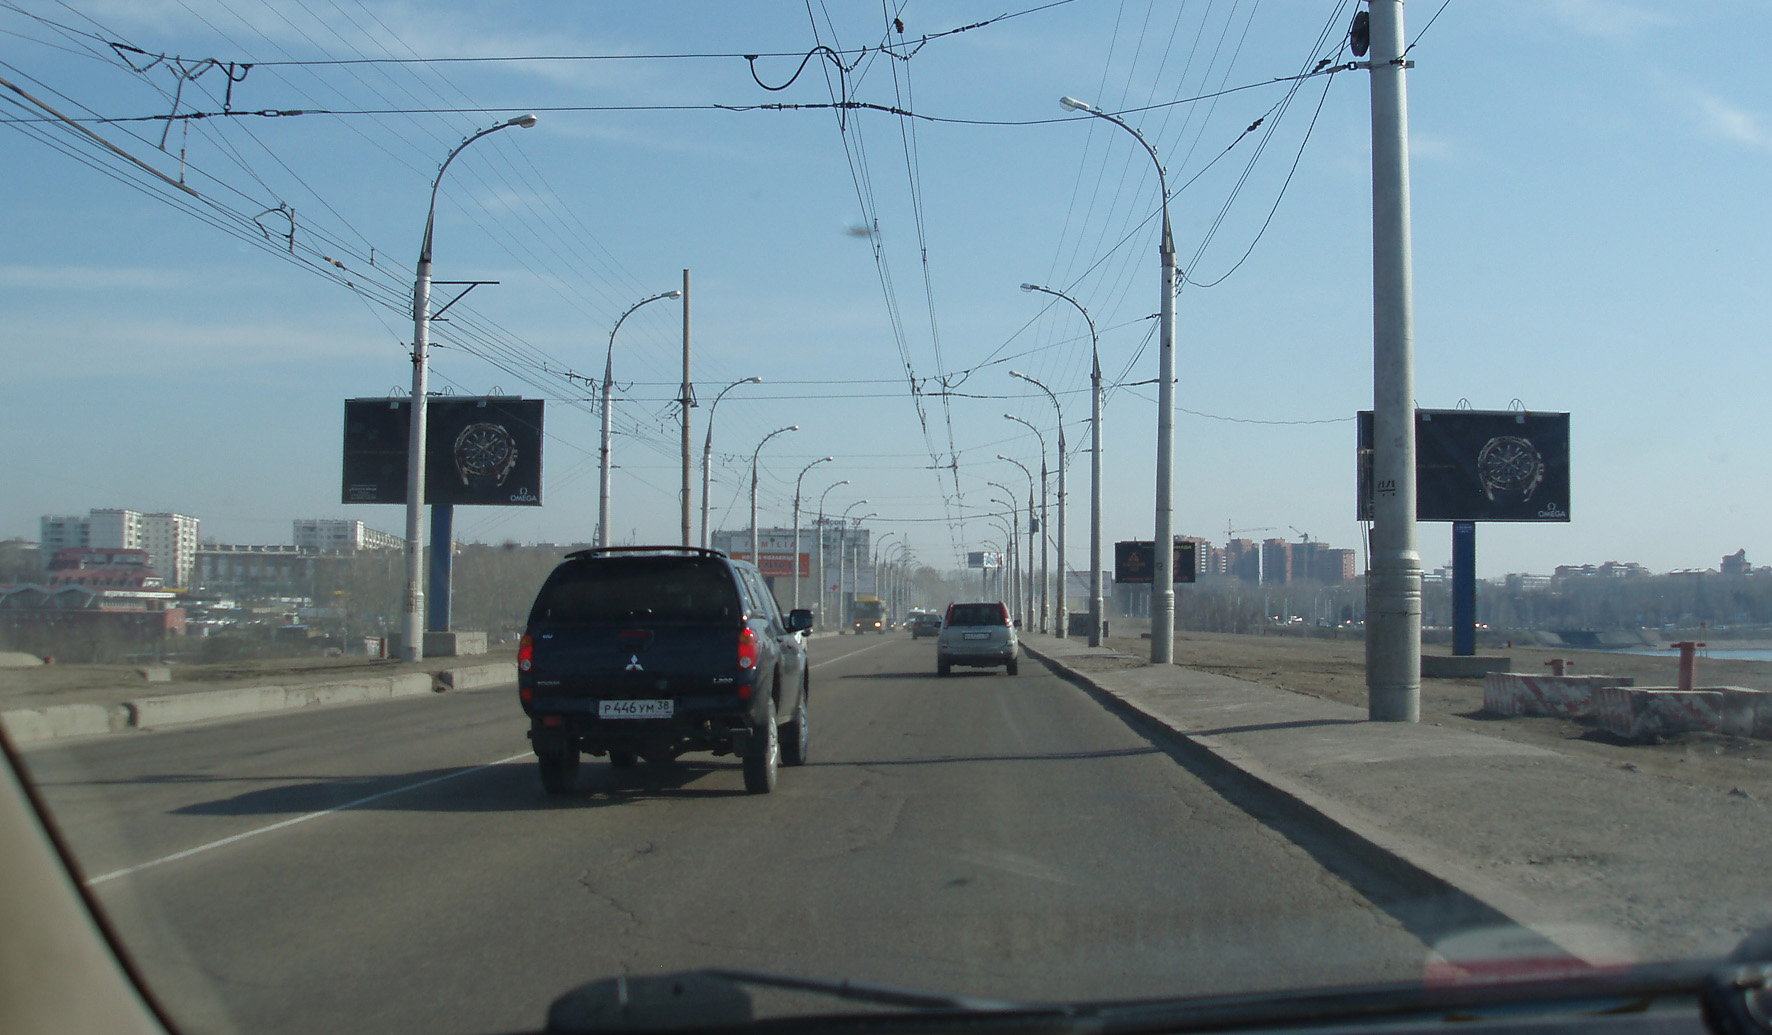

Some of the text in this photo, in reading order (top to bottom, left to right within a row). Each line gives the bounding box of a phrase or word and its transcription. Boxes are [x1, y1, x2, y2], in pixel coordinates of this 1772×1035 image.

[510, 494, 537, 502] OMEGA
[1538, 510, 1566, 518] OMEGA
[744, 540, 796, 548] FMILIA
[658, 701, 669, 710] 38
